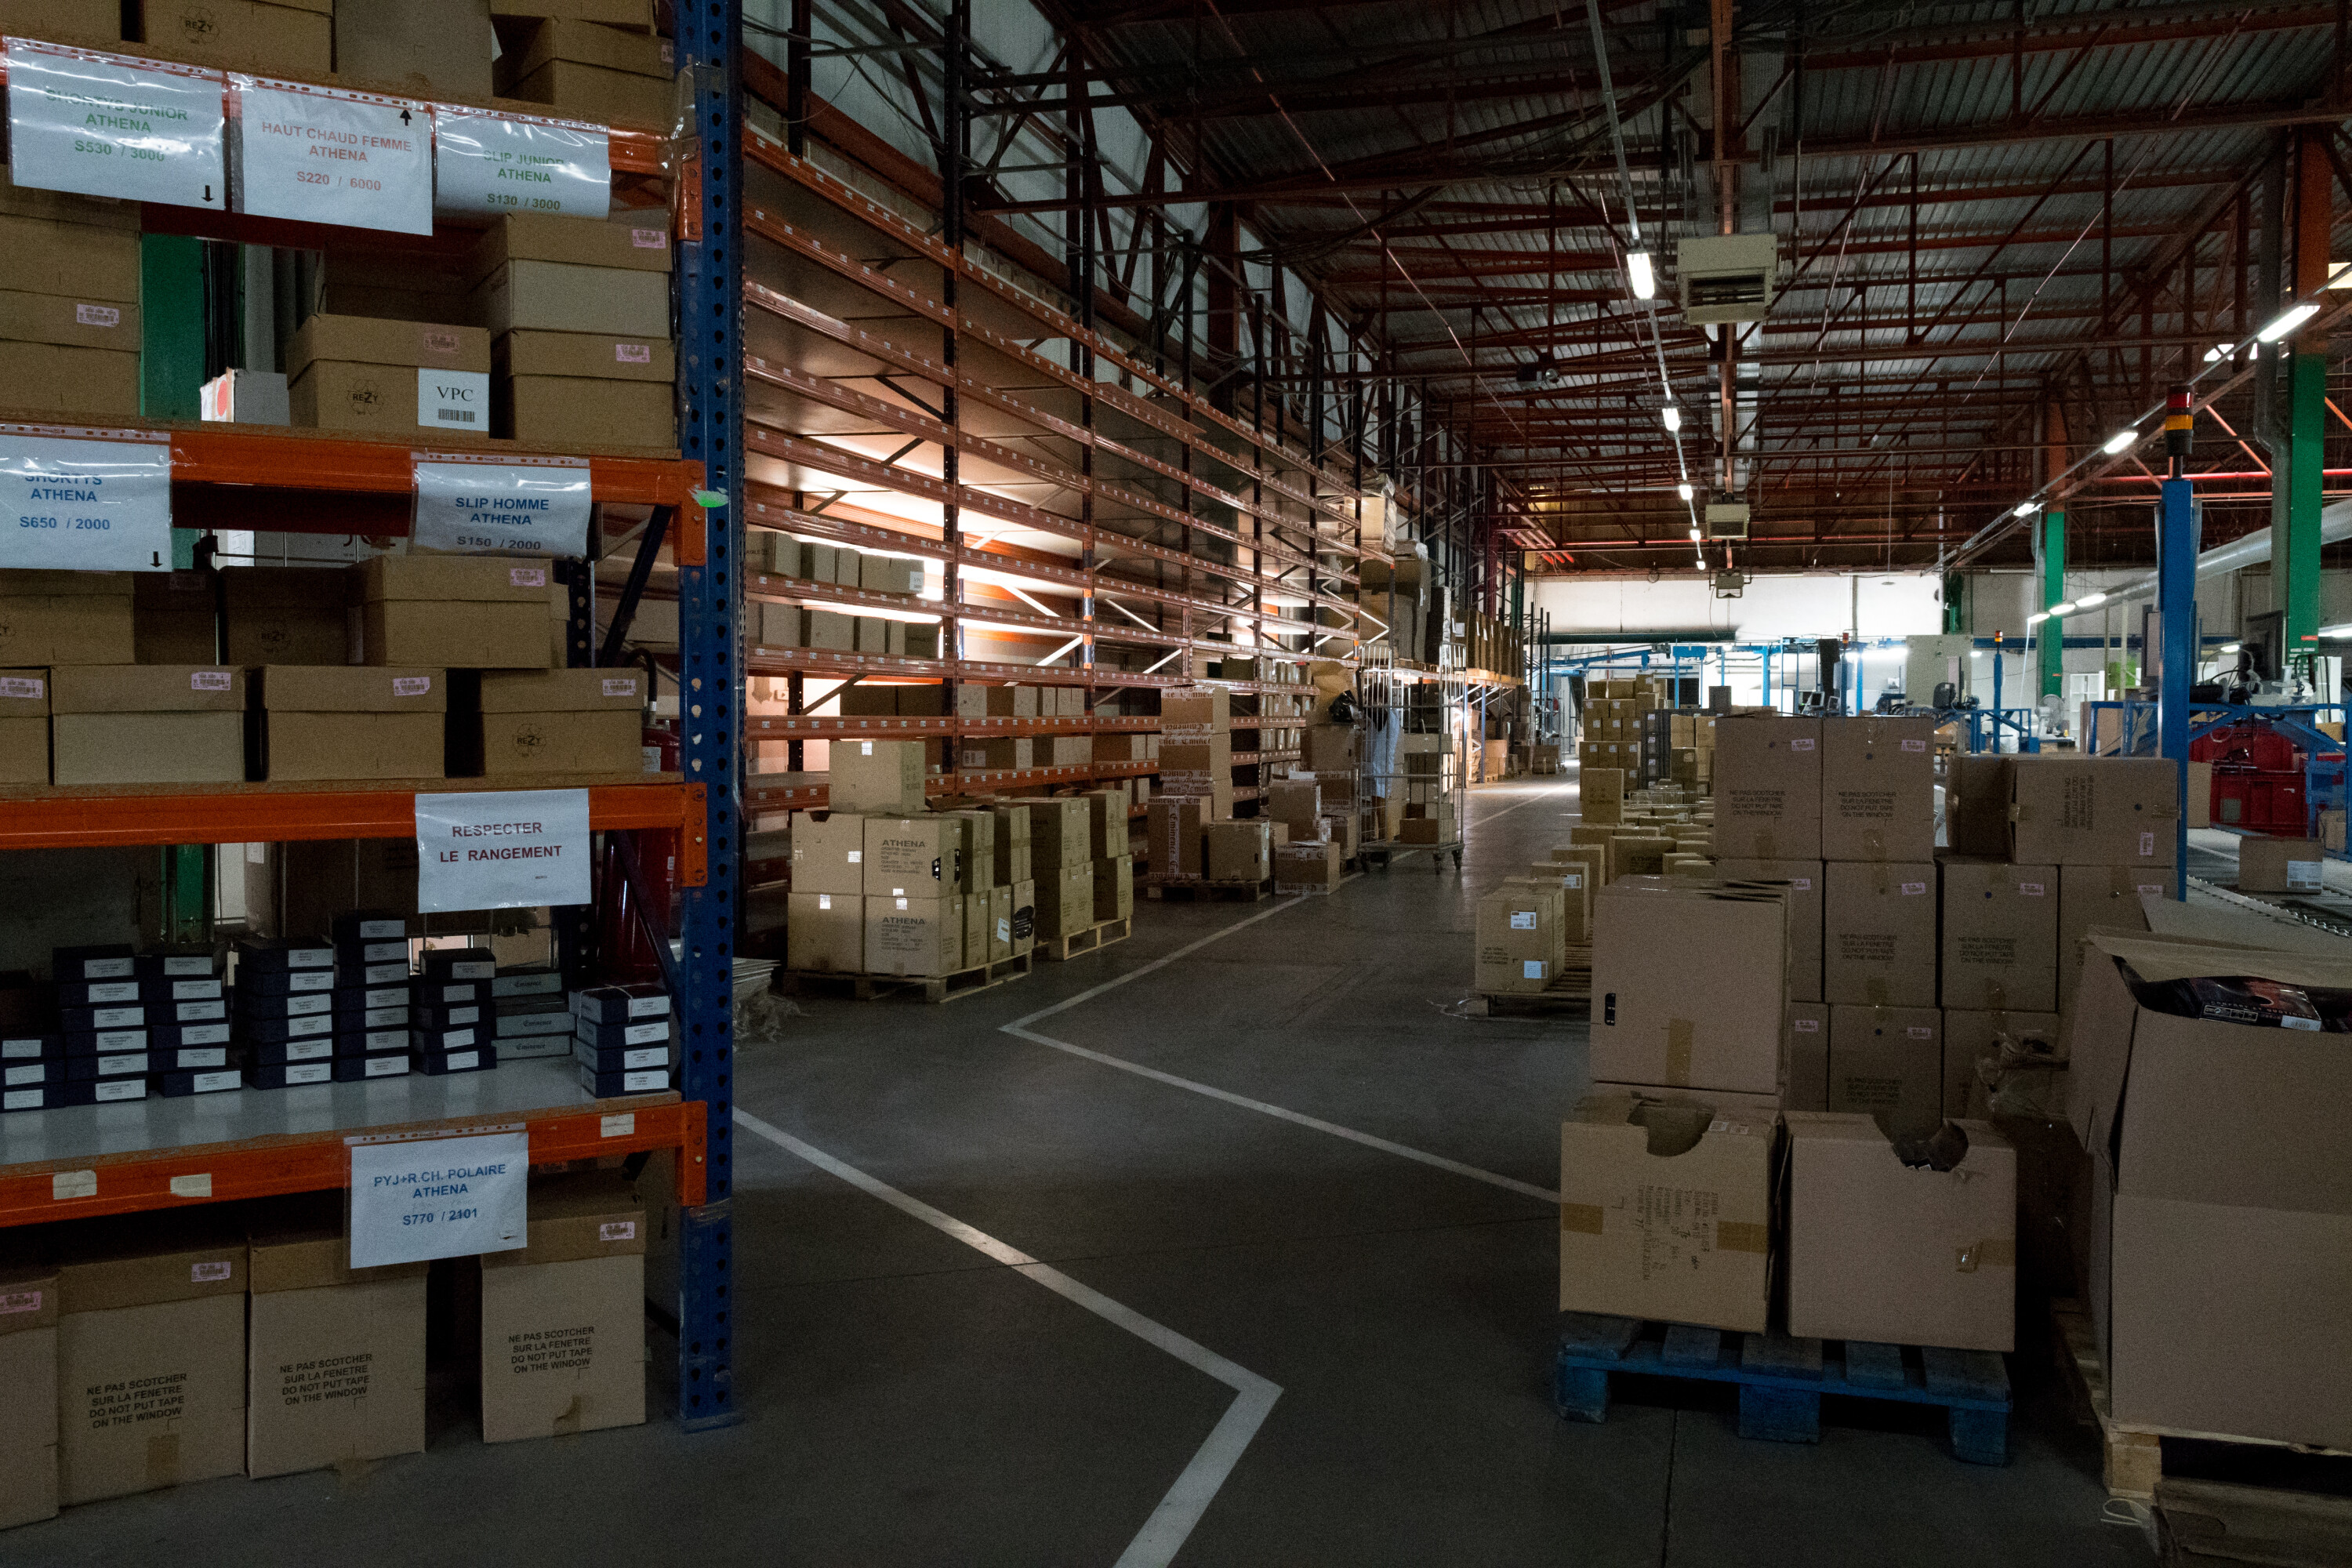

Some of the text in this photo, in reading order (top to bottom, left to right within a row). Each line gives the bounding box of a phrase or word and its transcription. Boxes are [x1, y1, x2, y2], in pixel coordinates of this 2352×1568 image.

[85, 114, 151, 132] ATHENA
[262, 122, 412, 152] HAUT CHAUD FEMME
[74, 140, 112, 155] S530
[130, 147, 165, 162] 3000
[309, 145, 368, 162] ATHENA
[483, 151, 512, 163] SLIP
[296, 171, 330, 185] S220
[350, 178, 382, 191] 6000
[498, 168, 552, 183] ATHENA
[487, 194, 517, 205] S130
[532, 198, 561, 210] 3000
[353, 392, 378, 404] REZY
[437, 387, 474, 401] VPC
[31, 488, 98, 502] ATHENA
[456, 497, 550, 510] SLIP HOMME
[20, 516, 57, 528] S650
[75, 518, 111, 530] 2000
[470, 513, 532, 525] ATHENA
[457, 536, 492, 546] S150
[508, 539, 542, 550] 2000
[452, 822, 543, 837] RESPECTER
[1169, 813, 1178, 855] Eminence
[440, 845, 562, 863] LE RANGEMENT
[448, 1163, 506, 1179] POLAIRE
[412, 1183, 469, 1198] ATHENA
[402, 1213, 434, 1226] S770
[524, 1332, 542, 1341] PAS
[544, 1326, 595, 1340] SCOTCHER
[513, 1336, 591, 1353] SUR LA FENETRE
[280, 1353, 372, 1374] NE PAS SCOTCHER
[511, 1347, 593, 1364] DO NOT PUT TAPE
[285, 1365, 368, 1384] SUR LA FENETRE
[514, 1358, 591, 1374] ON THE WINDOW
[86, 1373, 187, 1396] NE PAS SCOTCHER
[282, 1374, 370, 1396] DO NOT PUT TAPE
[92, 1385, 183, 1406] SUR LA FENETRE
[285, 1386, 368, 1406] ON THE WINDOW
[89, 1395, 184, 1418] DO NOT PUT TAPE
[93, 1406, 182, 1429] ON THE WINDOW
